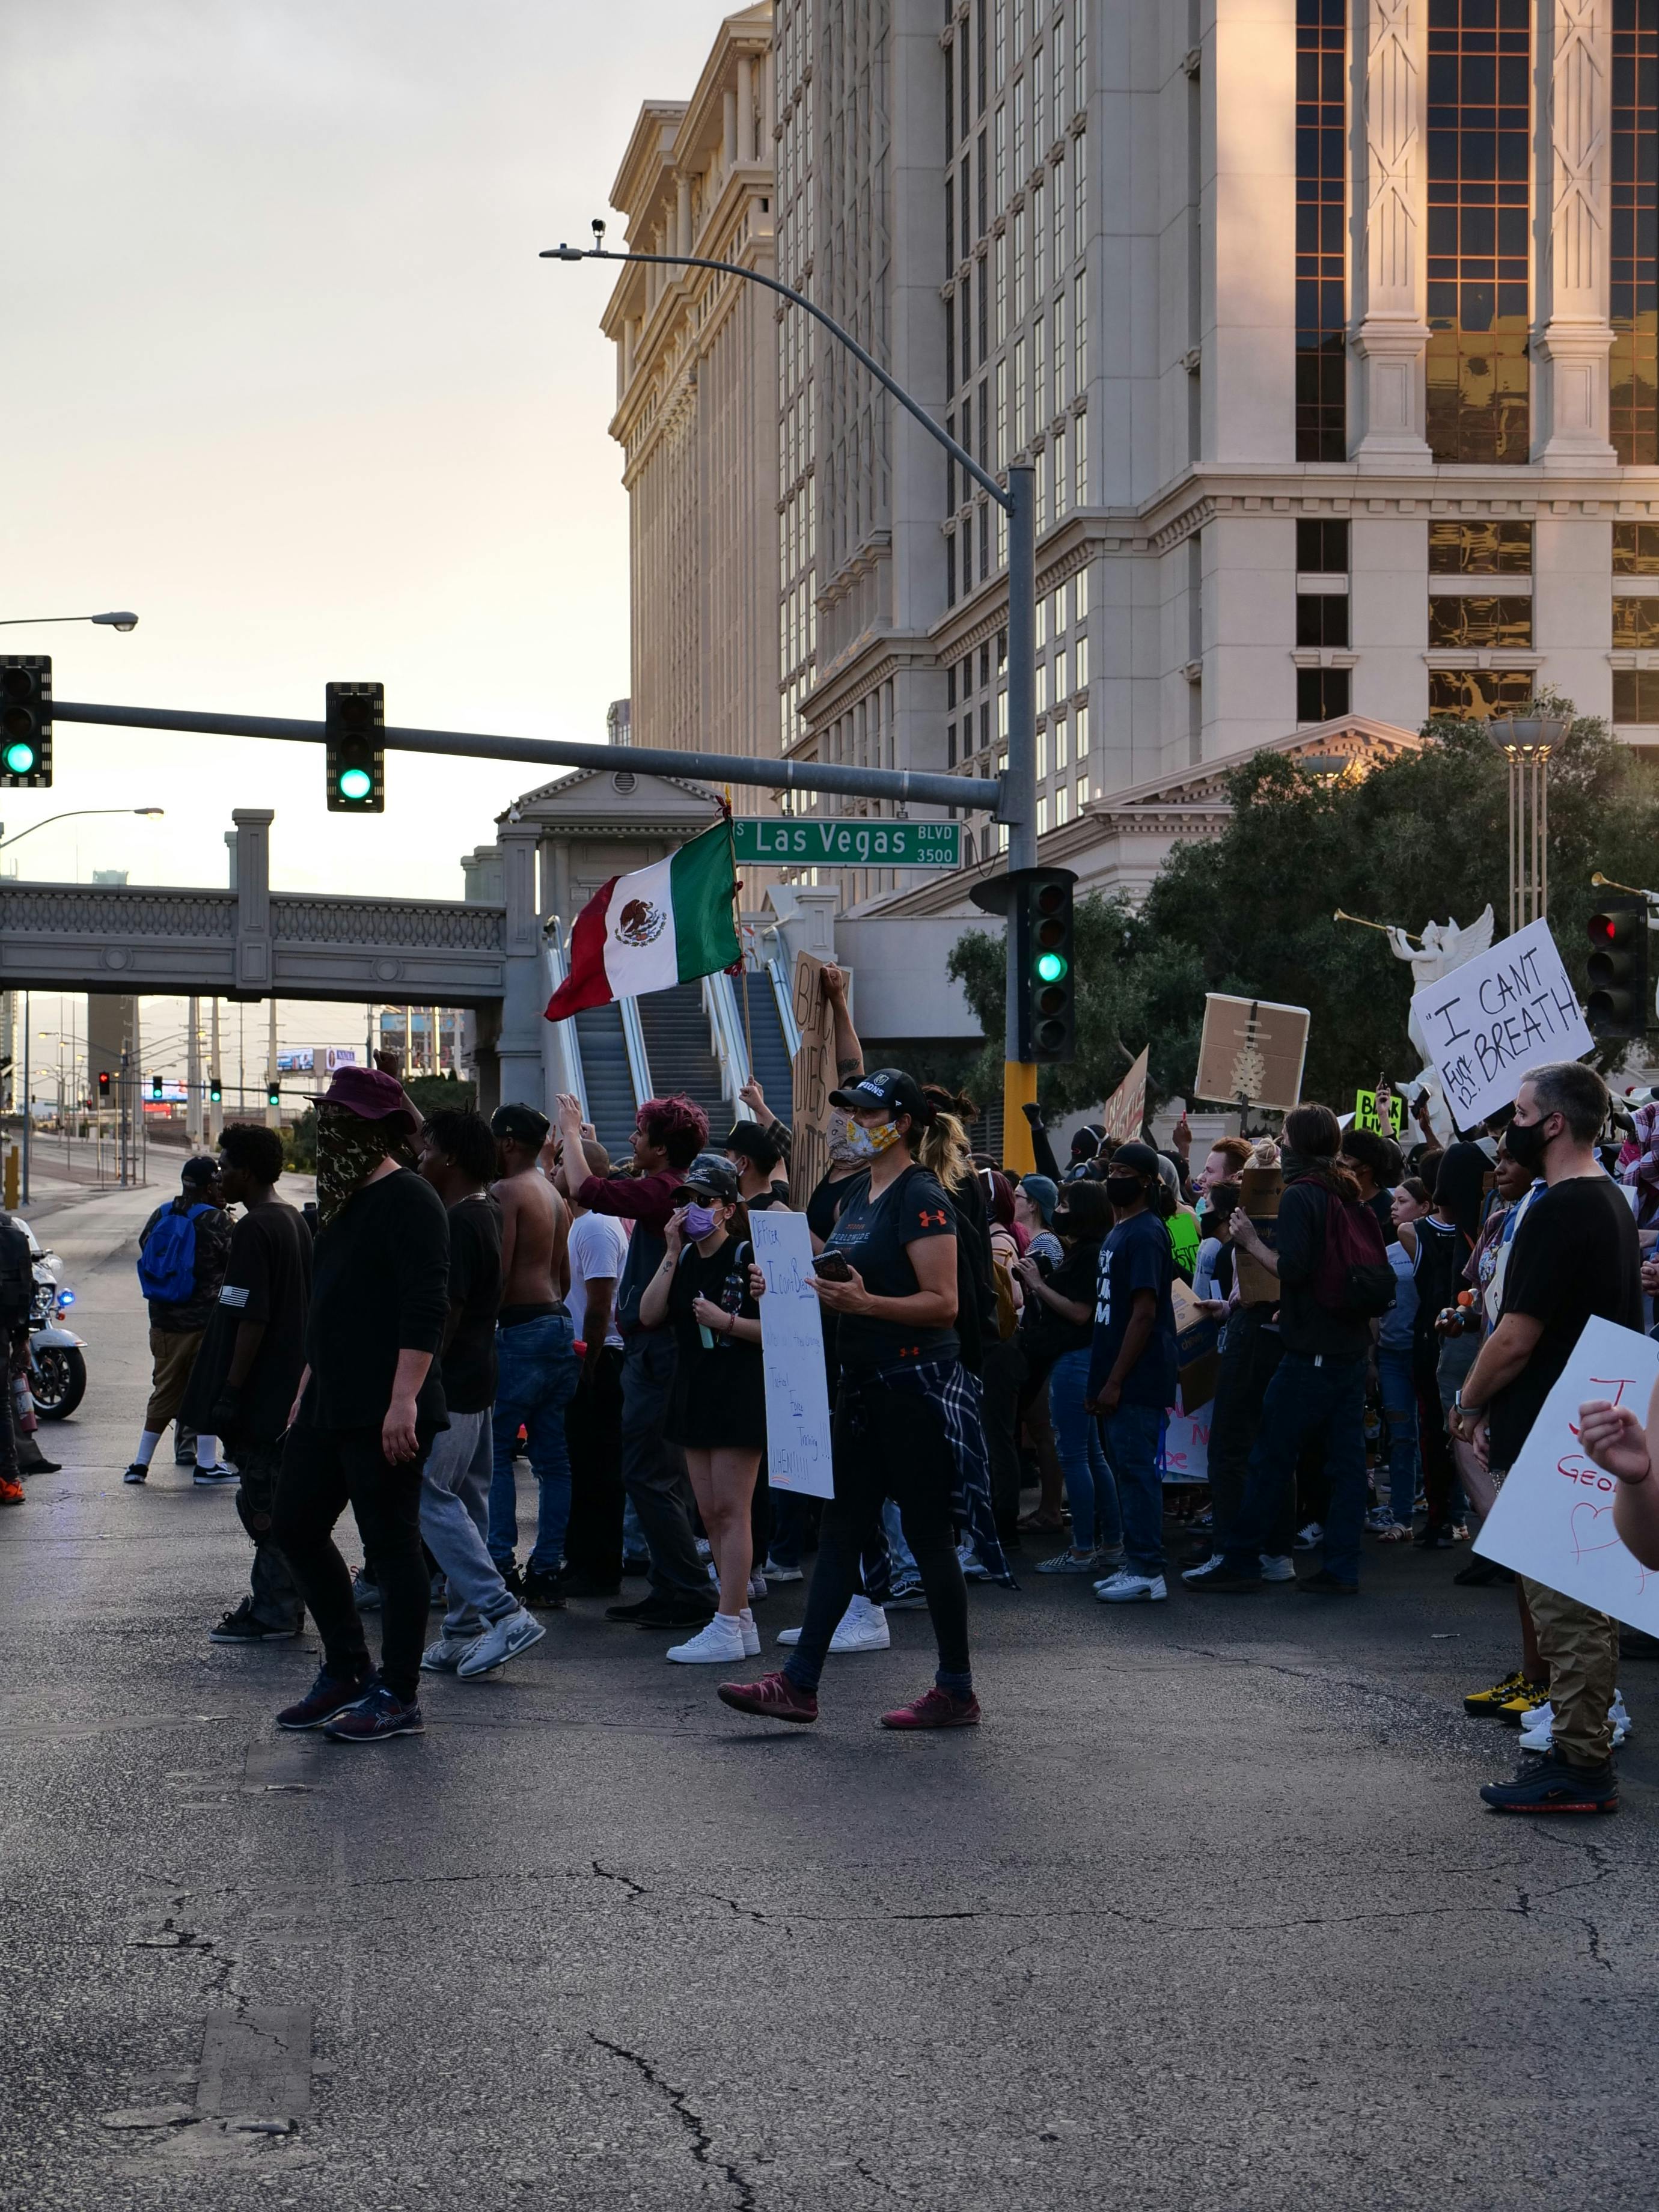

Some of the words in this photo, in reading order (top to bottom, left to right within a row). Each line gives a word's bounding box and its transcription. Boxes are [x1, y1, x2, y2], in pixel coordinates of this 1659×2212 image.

[736, 823, 744, 836] S
[756, 822, 806, 852] Las
[819, 823, 905, 861] Vegas
[918, 826, 952, 840] BLVD
[917, 849, 952, 863] 3500
[794, 1044, 828, 1122] LIVES
[1442, 1055, 1473, 1093] FUCK
[766, 1260, 778, 1294] I
[1557, 1455, 1617, 1493] GEO
